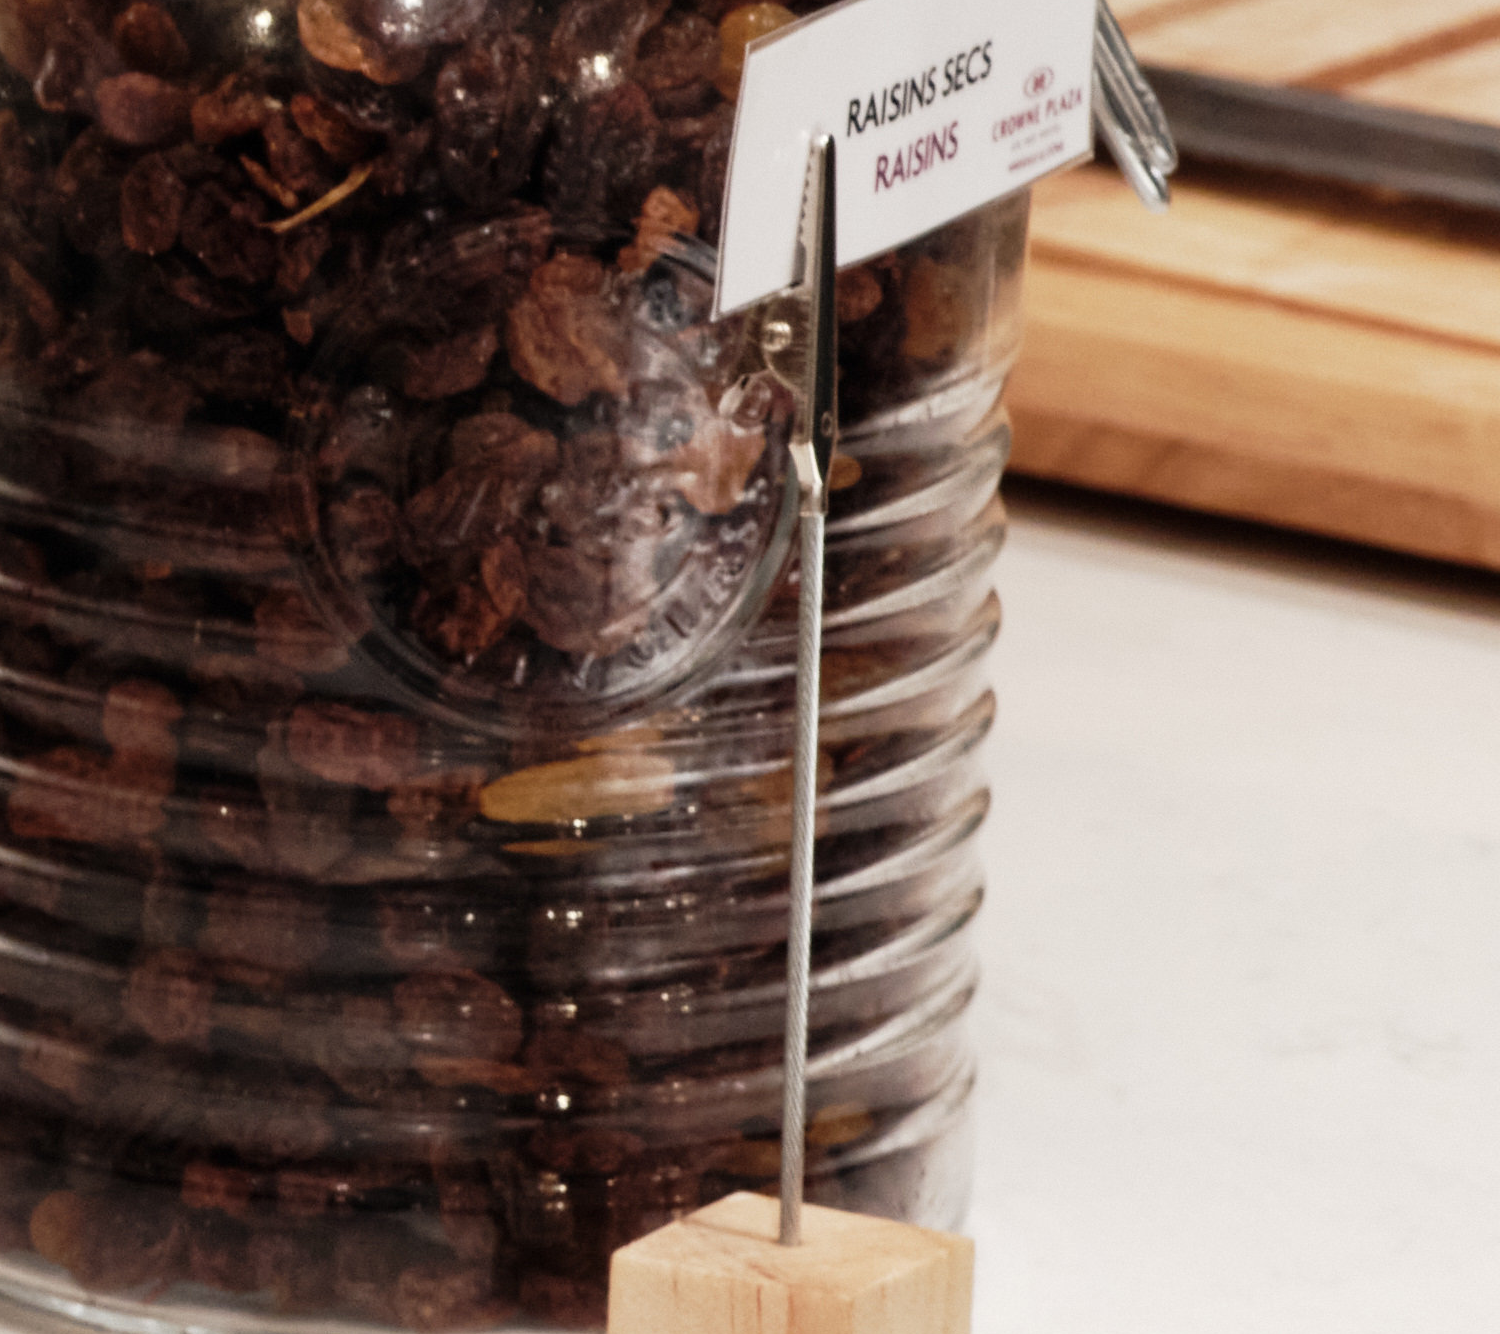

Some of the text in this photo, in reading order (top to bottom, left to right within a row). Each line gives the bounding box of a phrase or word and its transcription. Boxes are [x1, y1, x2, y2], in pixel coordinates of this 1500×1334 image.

[847, 66, 936, 138] RAISINS
[942, 40, 992, 97] SECS
[875, 120, 958, 194] RAISINS
